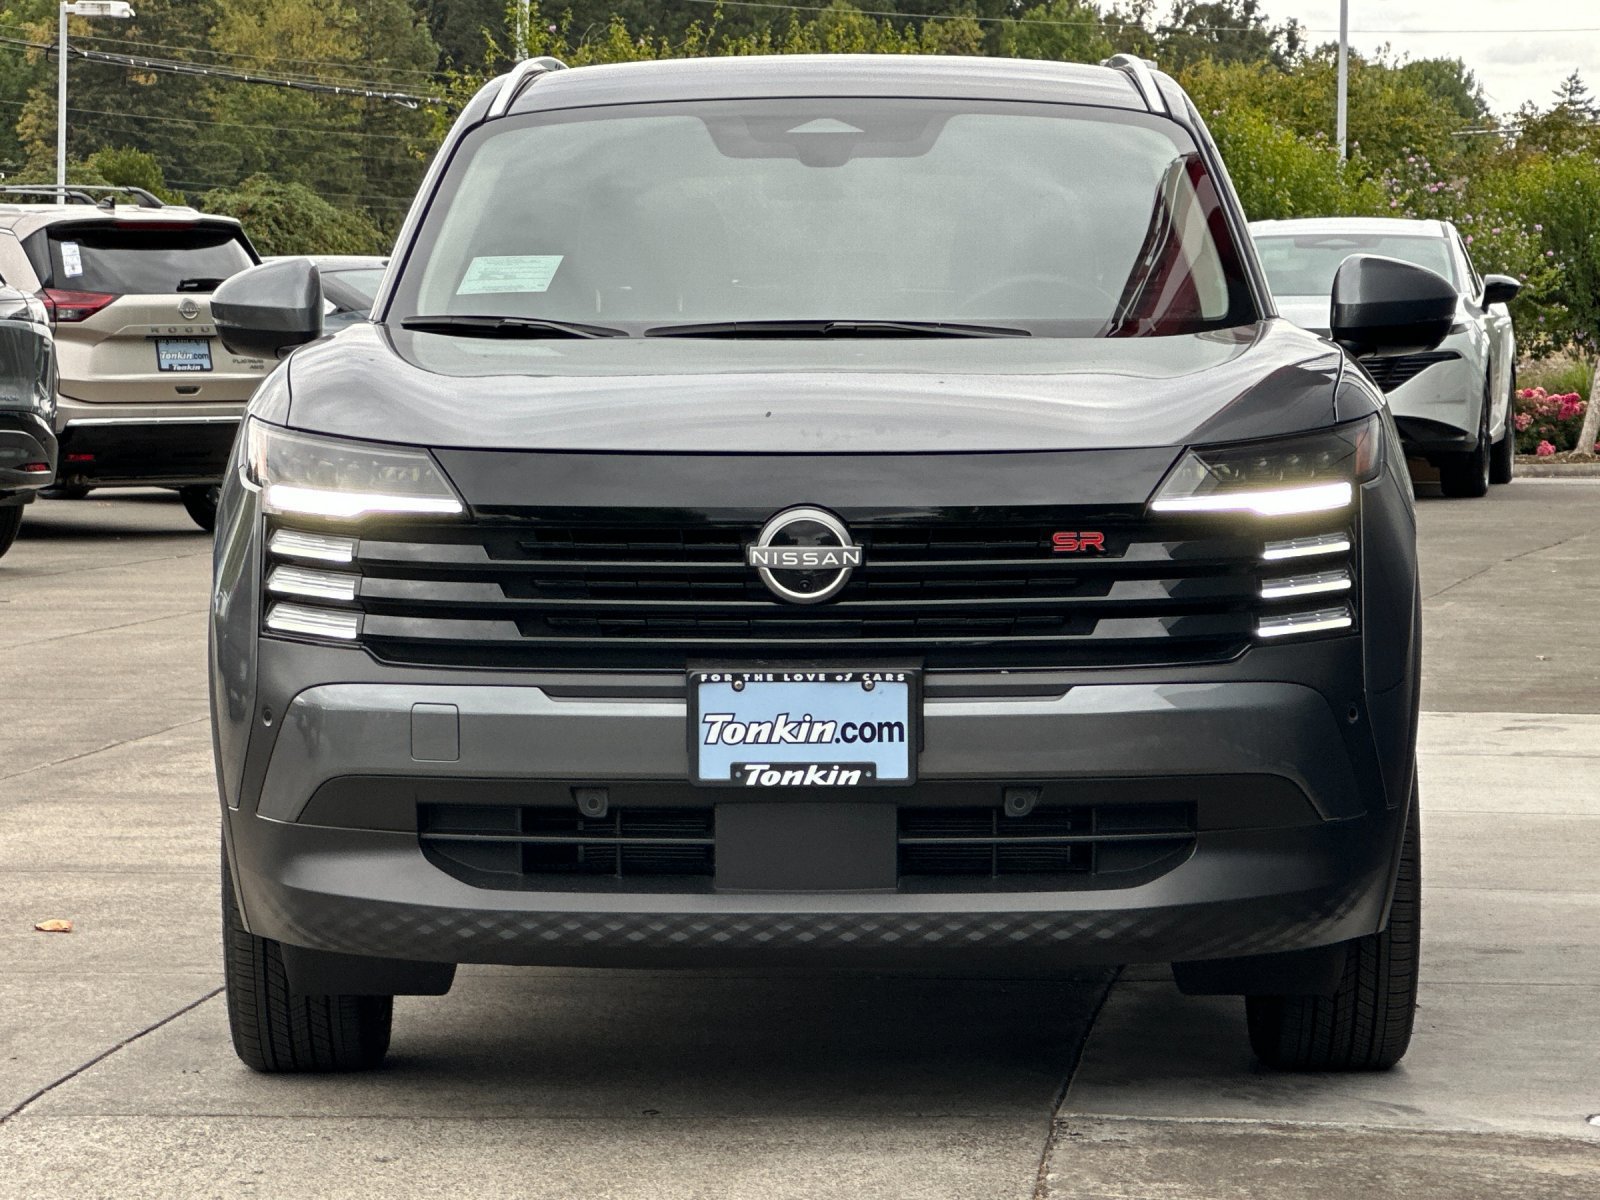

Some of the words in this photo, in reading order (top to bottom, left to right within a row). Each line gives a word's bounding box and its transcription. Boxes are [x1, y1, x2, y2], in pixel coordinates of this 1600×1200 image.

[151, 326, 211, 334] ROGU
[160, 351, 209, 360] Tonkin.com
[1052, 531, 1105, 552] SR
[751, 550, 861, 566] NISSAN
[701, 673, 733, 682] FOR
[743, 673, 774, 682] THE
[784, 673, 826, 682] LOVE
[835, 672, 853, 683] of
[862, 673, 905, 682] CARS
[702, 712, 905, 745] Tonkin.com
[744, 764, 861, 786] Tonkin
